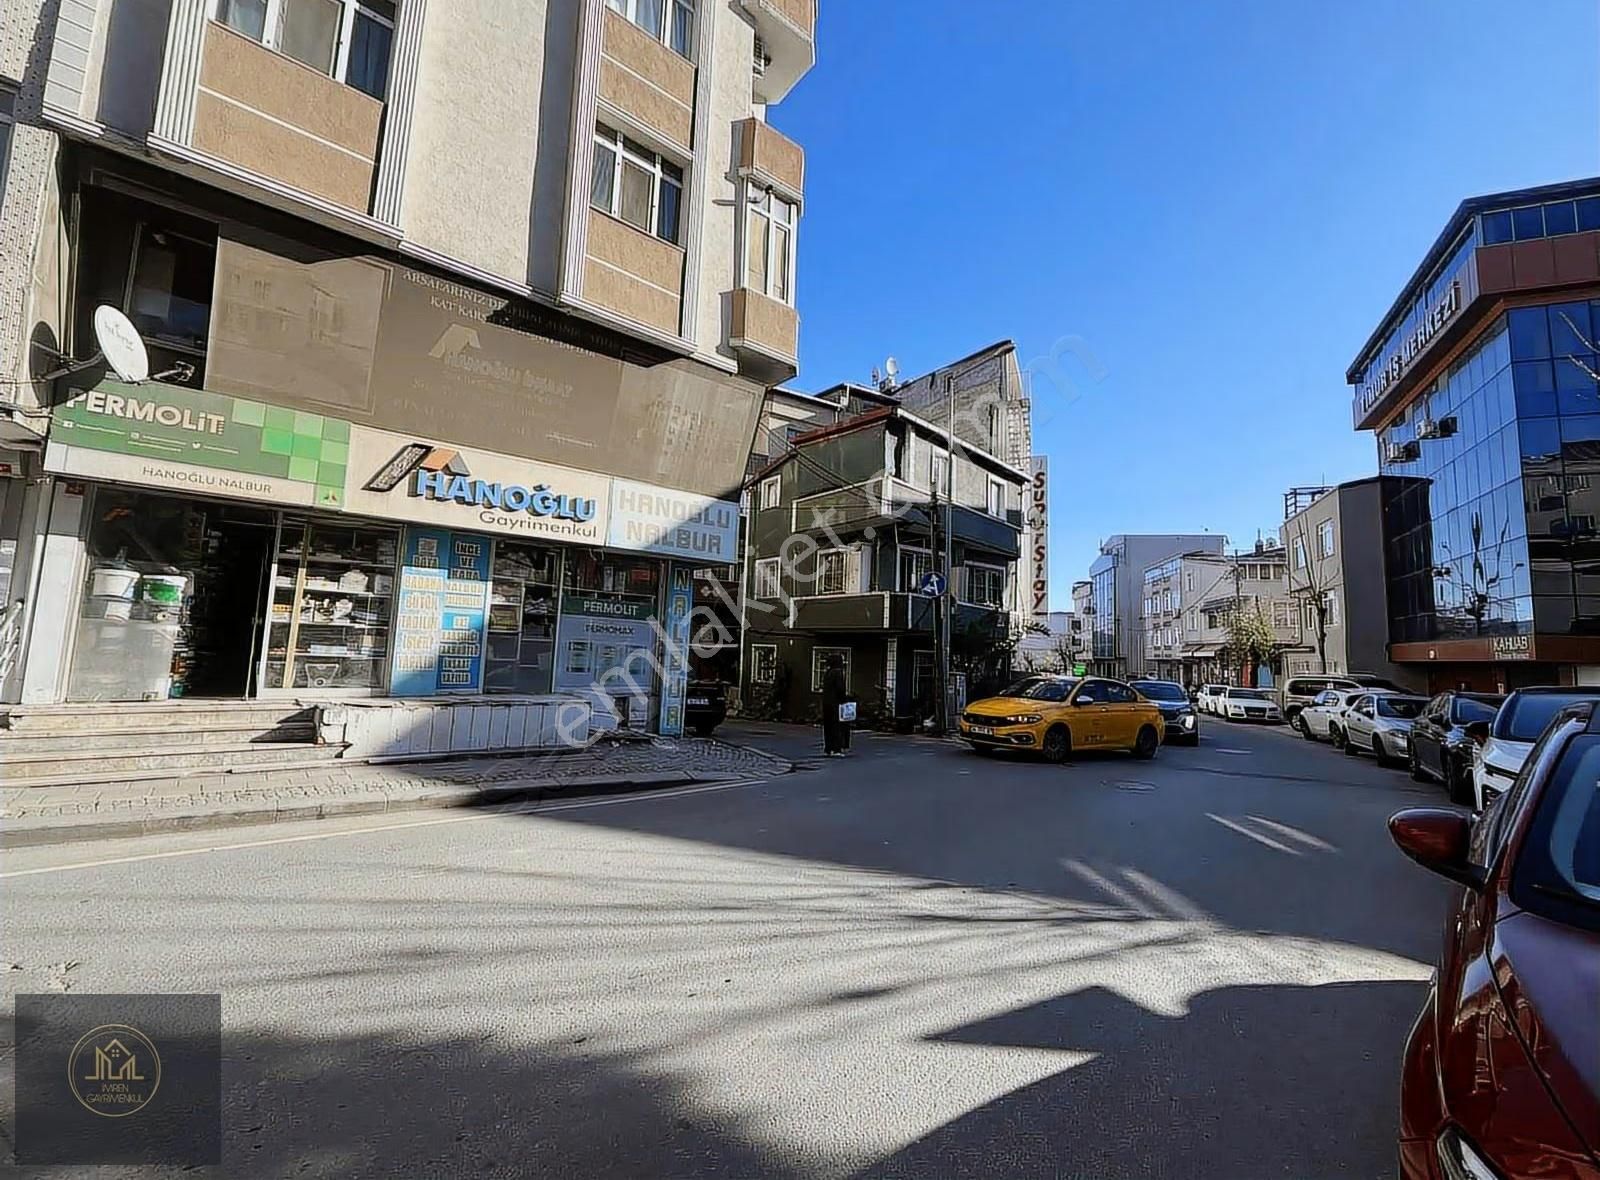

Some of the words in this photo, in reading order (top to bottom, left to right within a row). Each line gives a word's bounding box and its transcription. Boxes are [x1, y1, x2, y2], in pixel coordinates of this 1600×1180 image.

[219, 478, 273, 494] NALBUR
[408, 468, 597, 522] HANOĞLU
[479, 510, 597, 539] Gayrimenkul
[1032, 471, 1046, 611] SuprStay
